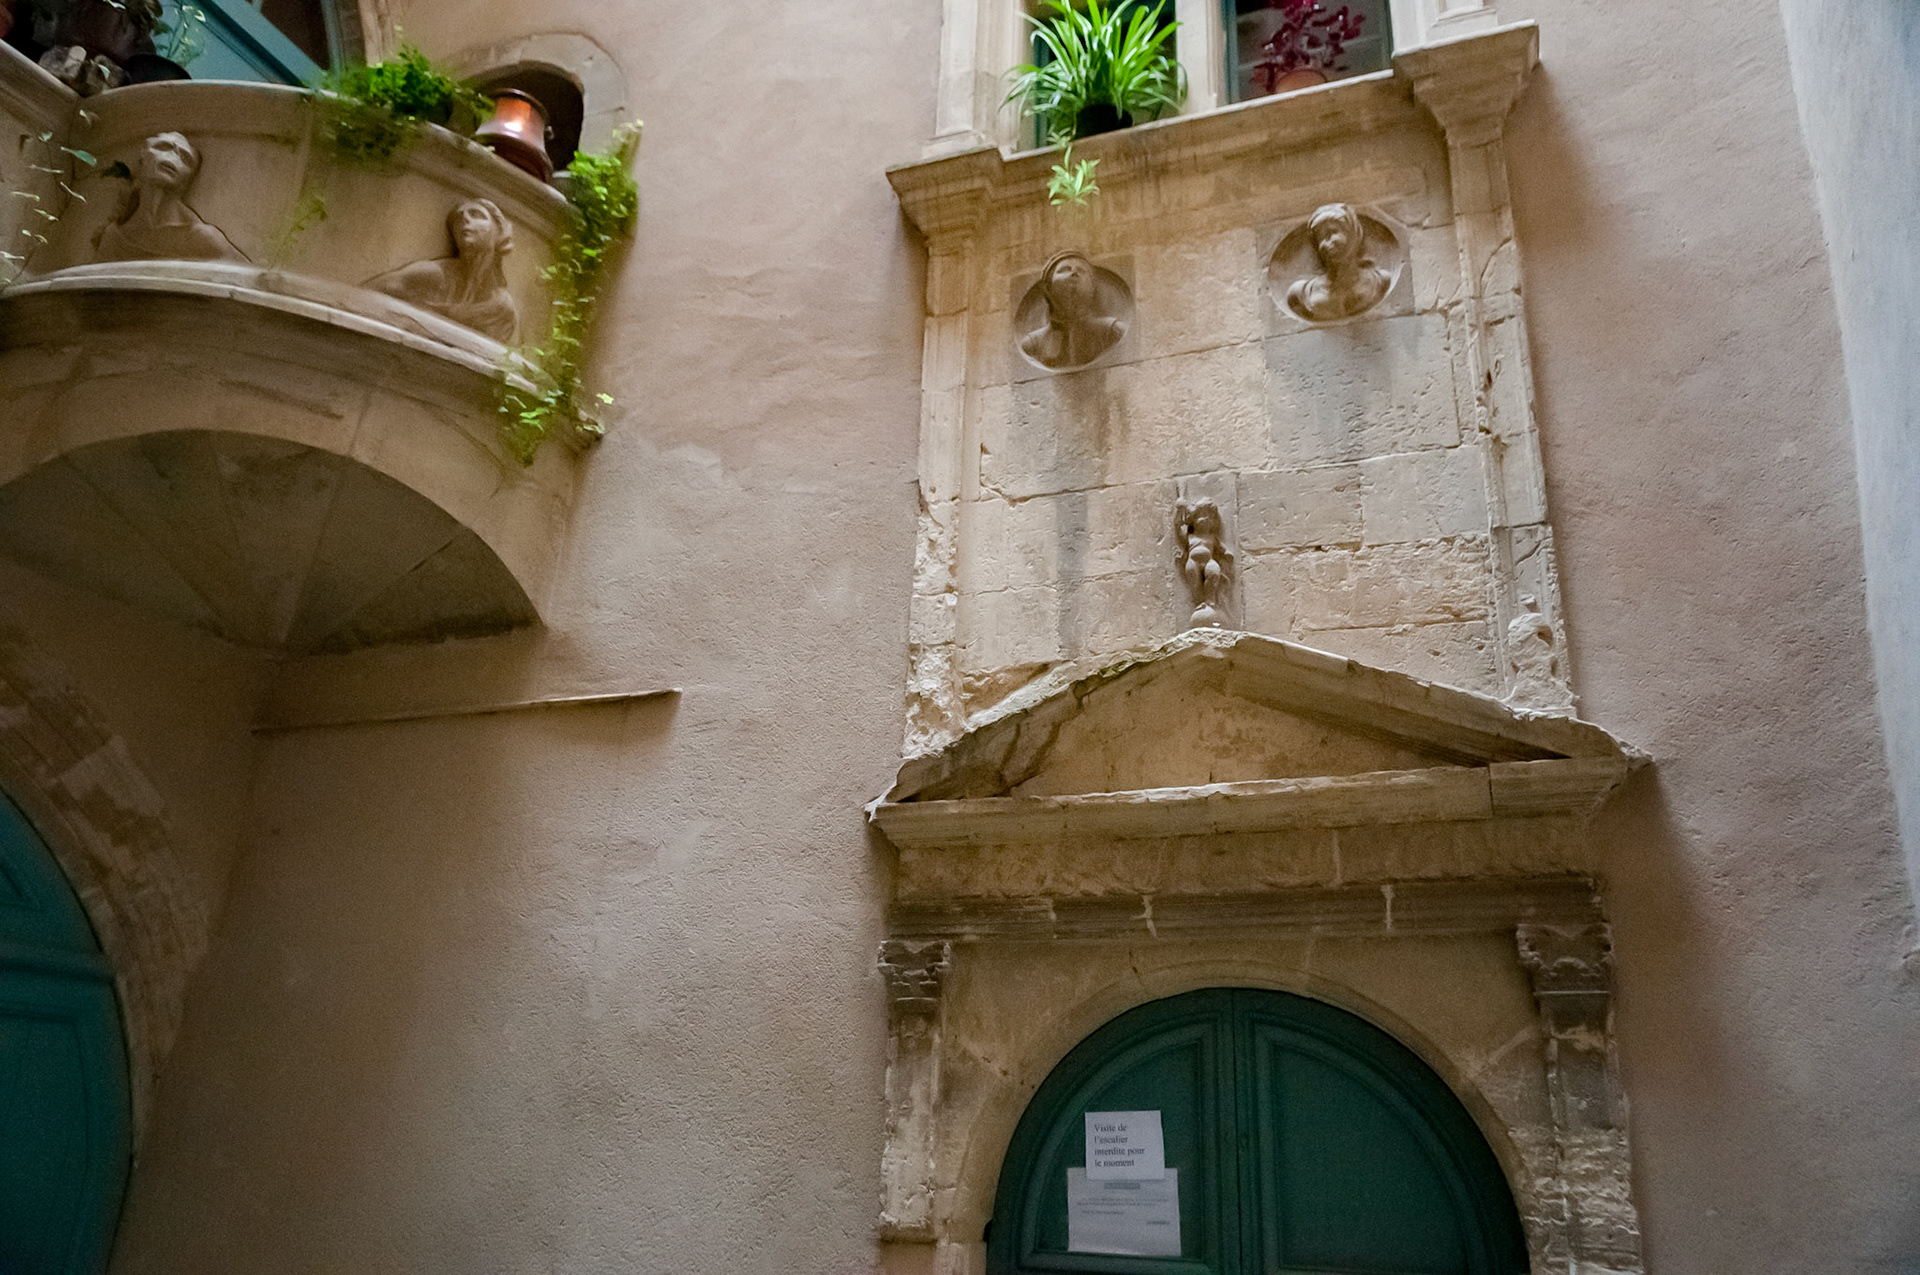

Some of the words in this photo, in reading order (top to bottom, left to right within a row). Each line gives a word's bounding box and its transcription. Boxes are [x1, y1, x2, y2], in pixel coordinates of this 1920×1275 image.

[1094, 1124, 1116, 1132] Visite
[1118, 1123, 1127, 1132] de
[1094, 1147, 1126, 1156] interdite
[1127, 1148, 1145, 1156] pour
[1094, 1159, 1102, 1167] le
